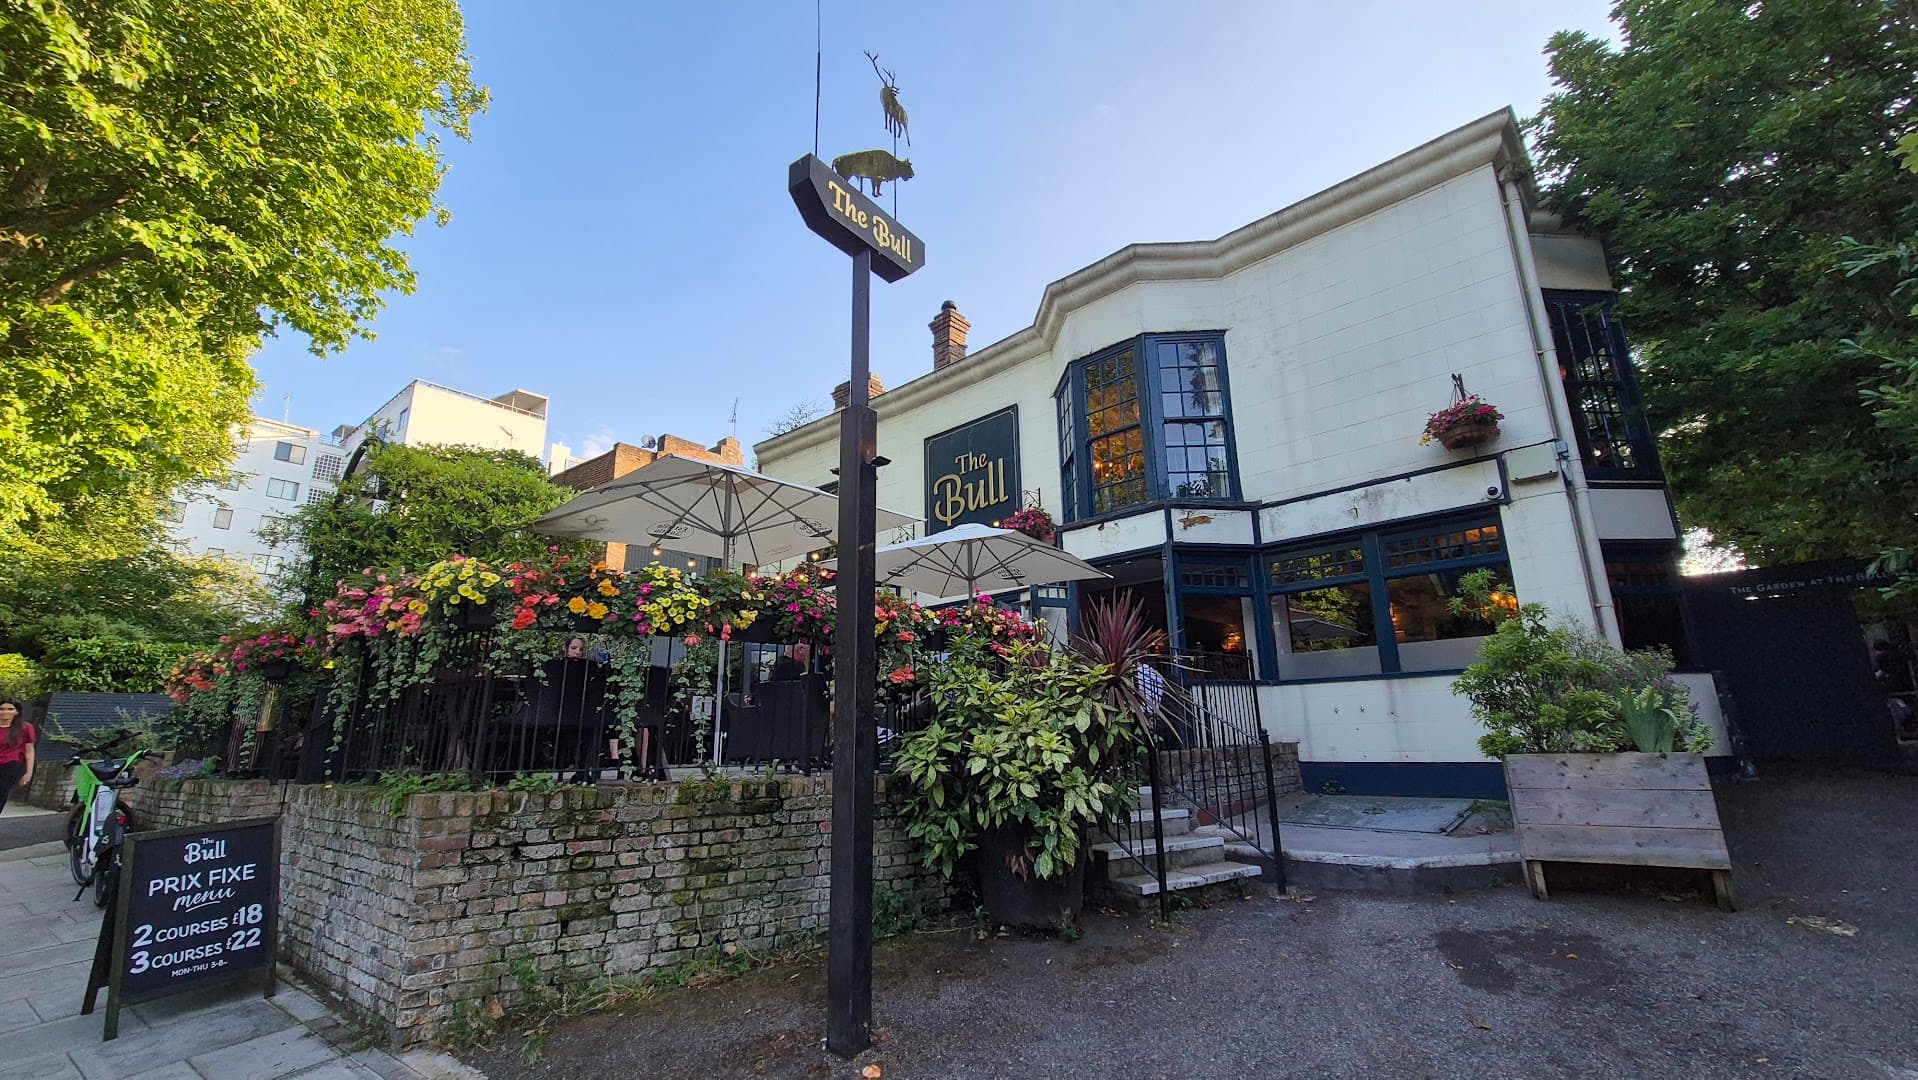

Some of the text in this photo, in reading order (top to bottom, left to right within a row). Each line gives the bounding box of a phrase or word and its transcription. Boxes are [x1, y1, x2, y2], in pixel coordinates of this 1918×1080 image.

[828, 180, 912, 264] The Bull
[954, 450, 988, 475] The
[933, 457, 1009, 527] Bull
[183, 839, 227, 865] Bull
[201, 837, 215, 845] The
[148, 863, 257, 897] PRIX FIXE
[172, 887, 237, 912] menu
[131, 903, 263, 948] 2 COURSES £18
[129, 927, 262, 975] 3 COURSES £22
[171, 962, 209, 977] MON-THU
